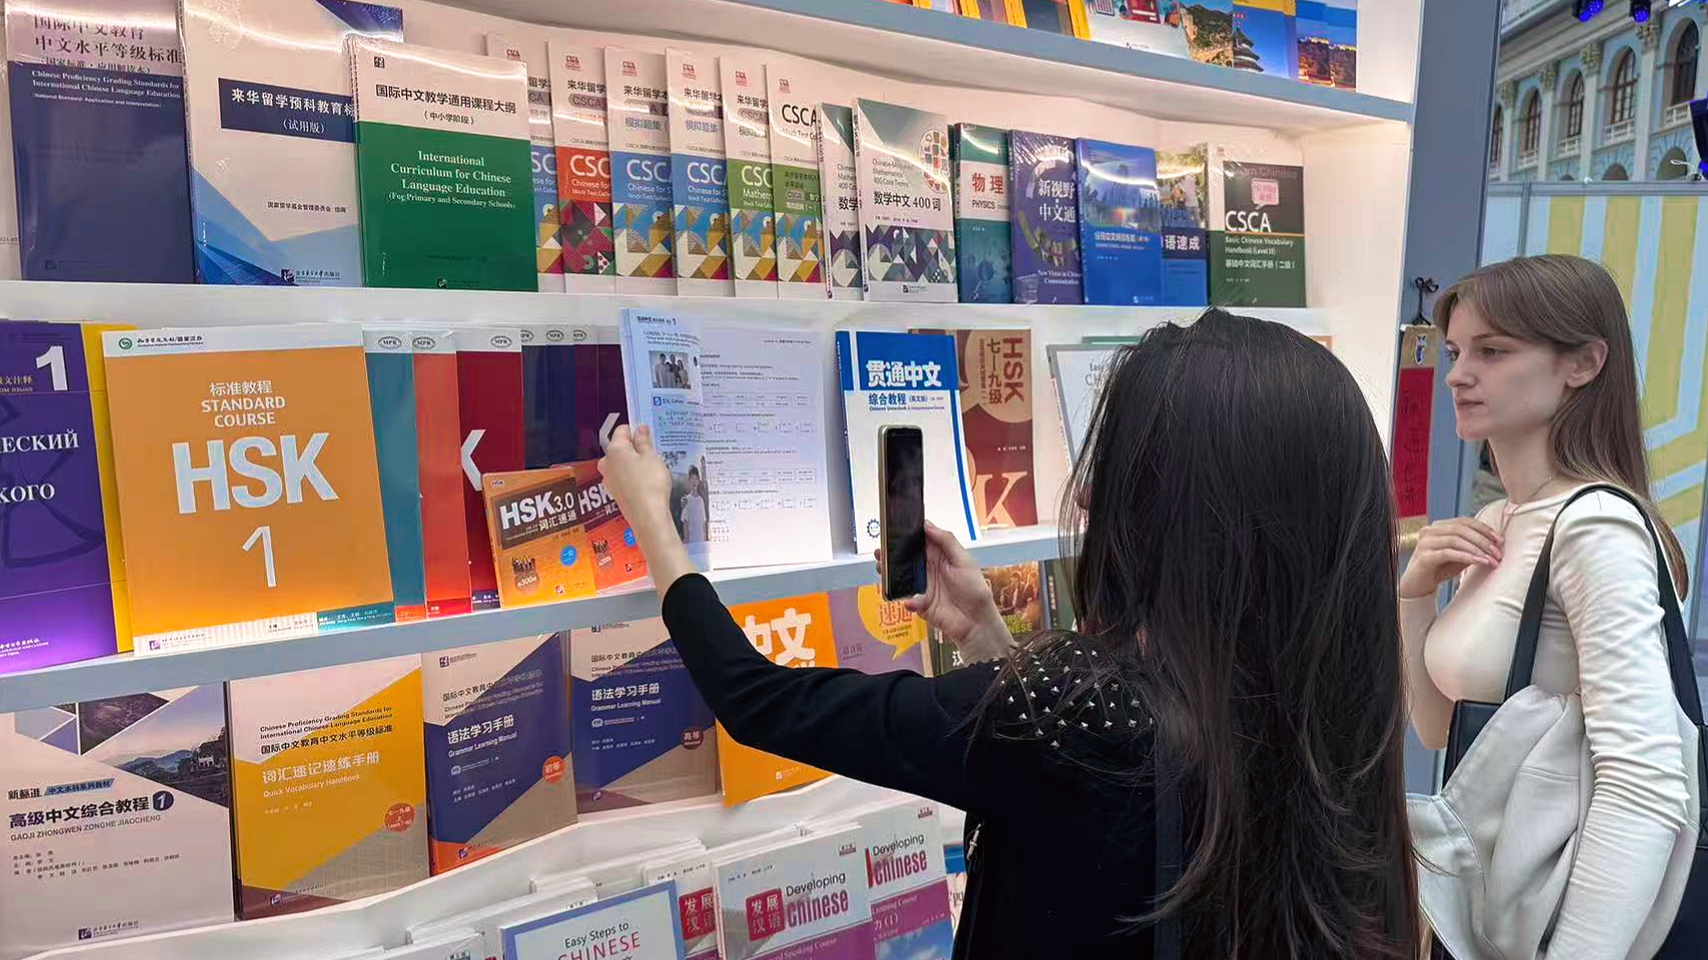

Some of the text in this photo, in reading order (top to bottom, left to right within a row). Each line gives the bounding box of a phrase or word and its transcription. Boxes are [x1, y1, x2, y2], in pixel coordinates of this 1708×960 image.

[35, 35, 183, 63] 中文水平等级标准
[32, 70, 60, 79] Chinese
[62, 73, 101, 83] Proficiency
[103, 77, 132, 86] Grading
[134, 80, 168, 88] Standards
[32, 80, 181, 98] International Chinese Language Education
[376, 84, 516, 114] 国际中文教学通用课程大纲
[782, 104, 817, 127] CSCA
[418, 151, 485, 166] International
[390, 163, 512, 183] Curriculum for Chinese
[572, 179, 599, 188] Chinese
[972, 173, 1004, 195] 物理
[401, 179, 506, 197] Language Education
[628, 183, 654, 193] Chinese
[688, 186, 712, 195] Chinese
[1038, 179, 1075, 199] 新视野
[406, 194, 436, 204] Primary
[452, 197, 488, 208] Secondary
[972, 199, 996, 210] PHYSICS
[1225, 210, 1272, 233] CSCA
[1162, 235, 1200, 251] 语速成
[1225, 246, 1252, 255] Handbook
[1264, 238, 1294, 246] Vocabulary
[36, 346, 68, 391] 1
[866, 360, 941, 388] 贯通中文
[1003, 337, 1024, 403] HSK
[210, 380, 273, 396] 标准教程
[869, 393, 907, 405] 综合教程
[201, 396, 285, 413] STANDARD
[214, 412, 275, 428] COURSE
[0, 428, 79, 453] ЕСКИЙ
[172, 432, 339, 514] HSK
[539, 510, 577, 531] 词汇速通
[241, 525, 277, 588] 1
[742, 608, 815, 666] 中文
[592, 683, 660, 701] 语法学习手册
[591, 703, 616, 712] Grammar
[617, 700, 641, 709] Learning
[260, 724, 286, 733] Chinese
[288, 716, 322, 728] Proficiency
[324, 712, 350, 722] Grading
[351, 708, 382, 717] Standards
[260, 714, 393, 740] International Chinese Language Education
[447, 715, 514, 744] 语法学习手册
[260, 725, 393, 755] 国际中文教育中文水平等级标准
[448, 731, 517, 757] Grammar Learning Manual
[263, 751, 380, 784] 词汇速记速练手册
[264, 773, 360, 798] Quick Vocabulary Handbook
[157, 793, 166, 808] 1
[9, 797, 149, 828] 高级中文综合教程
[11, 815, 161, 841] GAOJI ZHONGWEN ZONGHE JIAOCHENG
[873, 834, 924, 856] Developing
[786, 872, 846, 897] Developing
[684, 893, 714, 915] 发展
[751, 894, 779, 916] 发展
[753, 911, 781, 935] 汉语
[565, 922, 629, 949] Easy Steps to
[815, 938, 837, 951] Course
